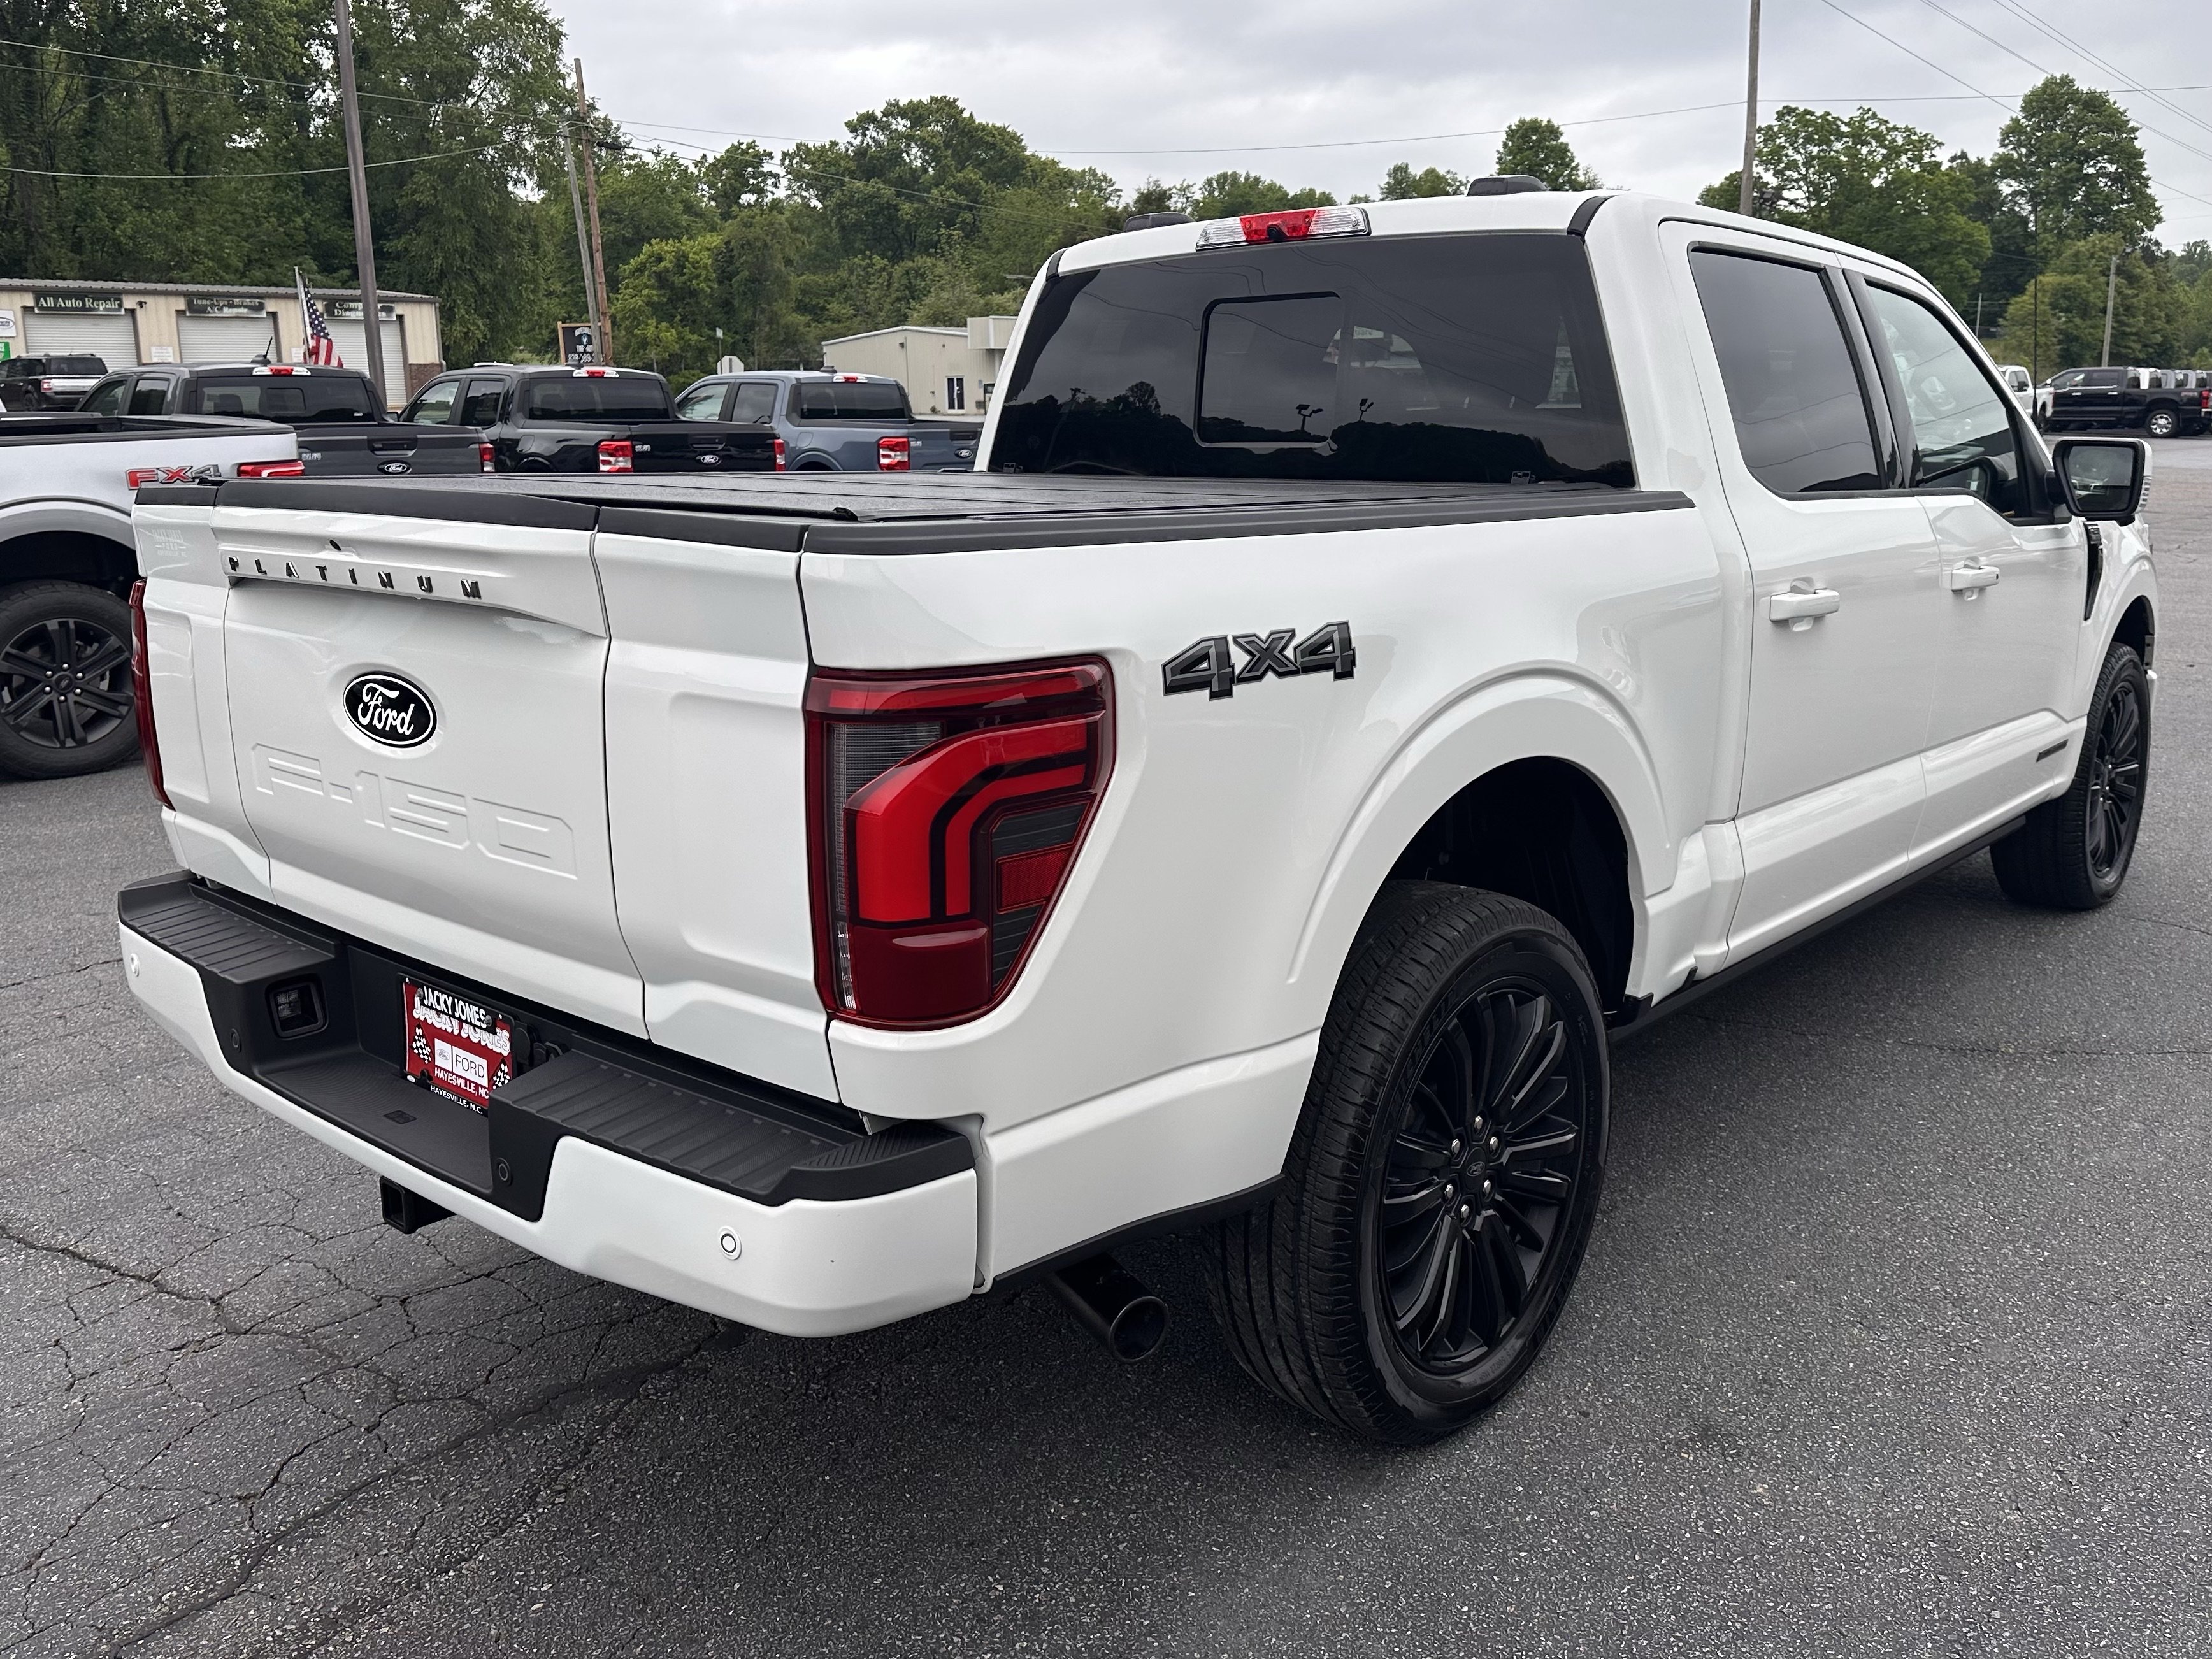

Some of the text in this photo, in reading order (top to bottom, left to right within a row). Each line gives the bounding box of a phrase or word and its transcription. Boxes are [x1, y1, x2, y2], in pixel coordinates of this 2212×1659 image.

[38, 297, 121, 310] All Auto Repair
[126, 452, 222, 490] FX4
[228, 556, 482, 599] PLATINUM
[357, 682, 415, 736] Ford
[252, 743, 577, 879] F-150
[424, 986, 487, 1028] JACKY JONES
[434, 1067, 477, 1096] HAYESVILLE,
[479, 1087, 489, 1099] NC
[455, 1054, 485, 1078] FORD
[431, 1085, 482, 1114] HAYESVILLE, N.C.
